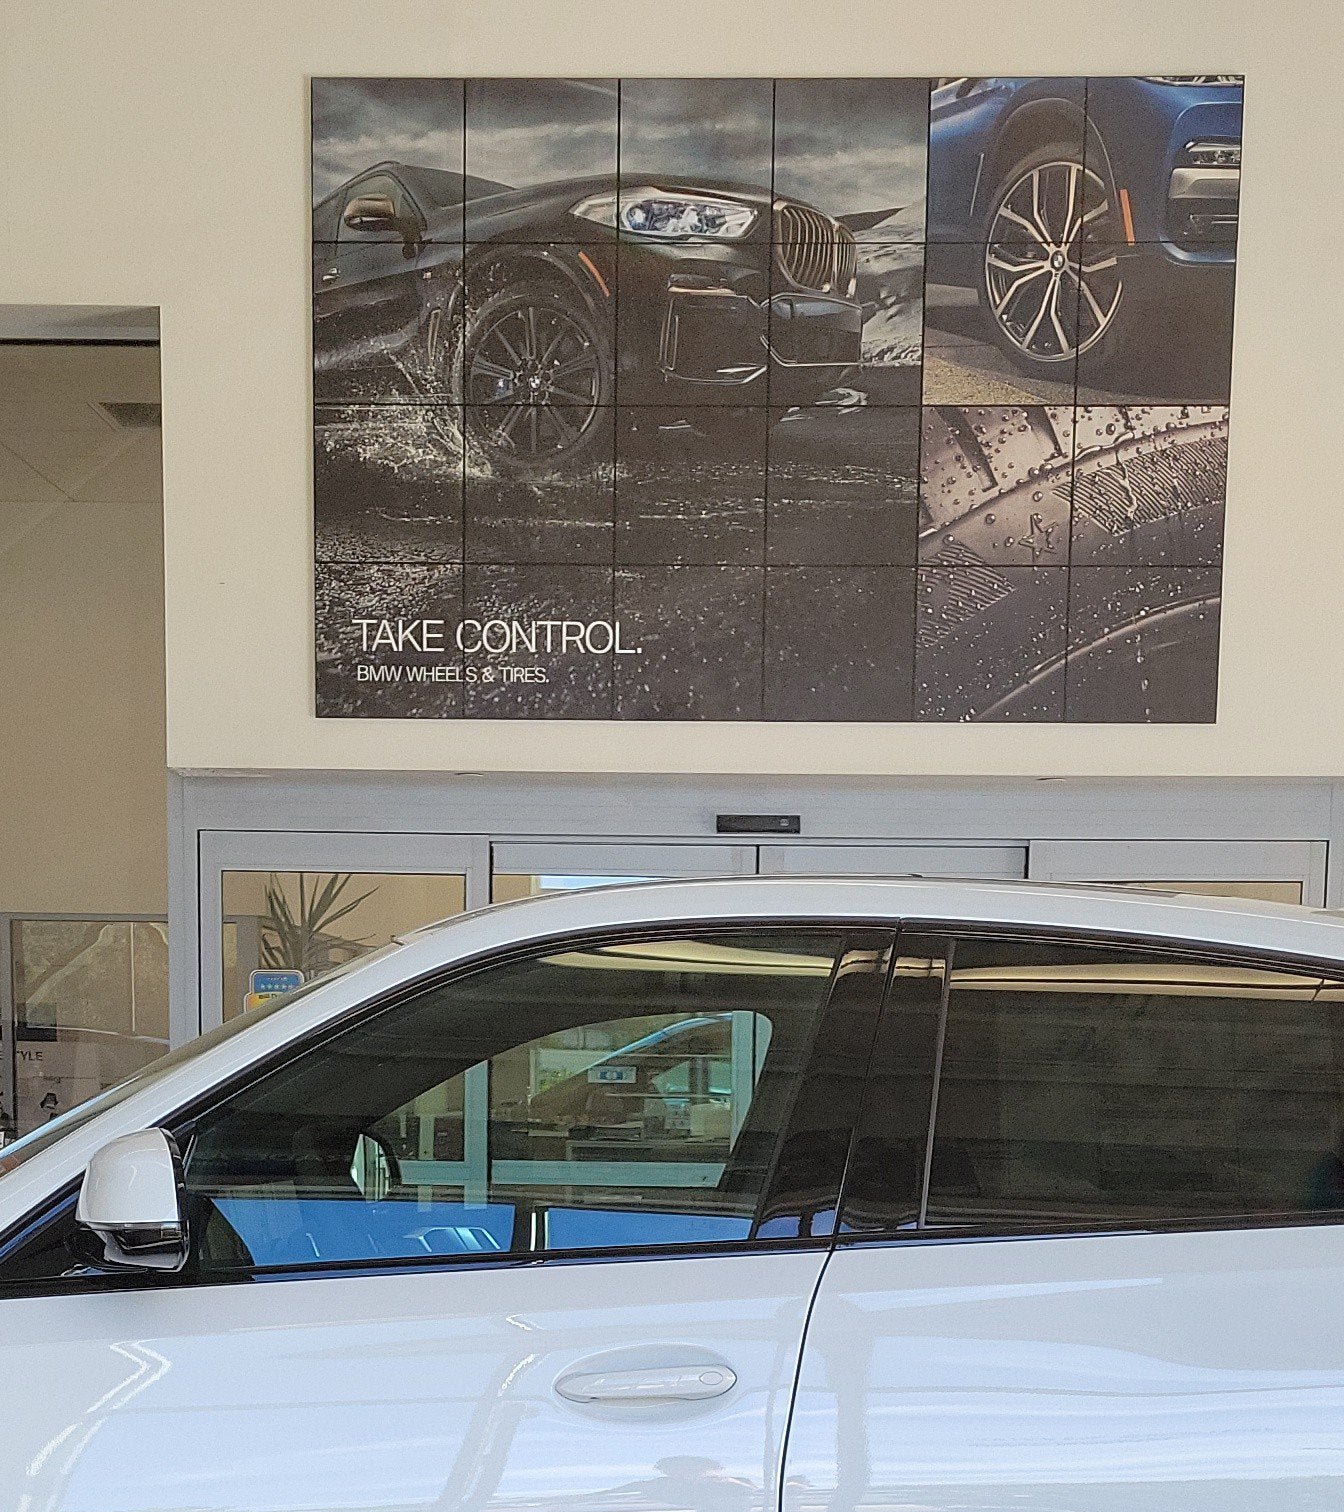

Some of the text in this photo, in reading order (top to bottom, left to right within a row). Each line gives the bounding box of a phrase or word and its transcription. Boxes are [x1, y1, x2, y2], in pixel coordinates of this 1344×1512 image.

[352, 618, 643, 655] TAKE CONTROL.
[357, 665, 550, 685] BMW WHEELS & TIRES.
